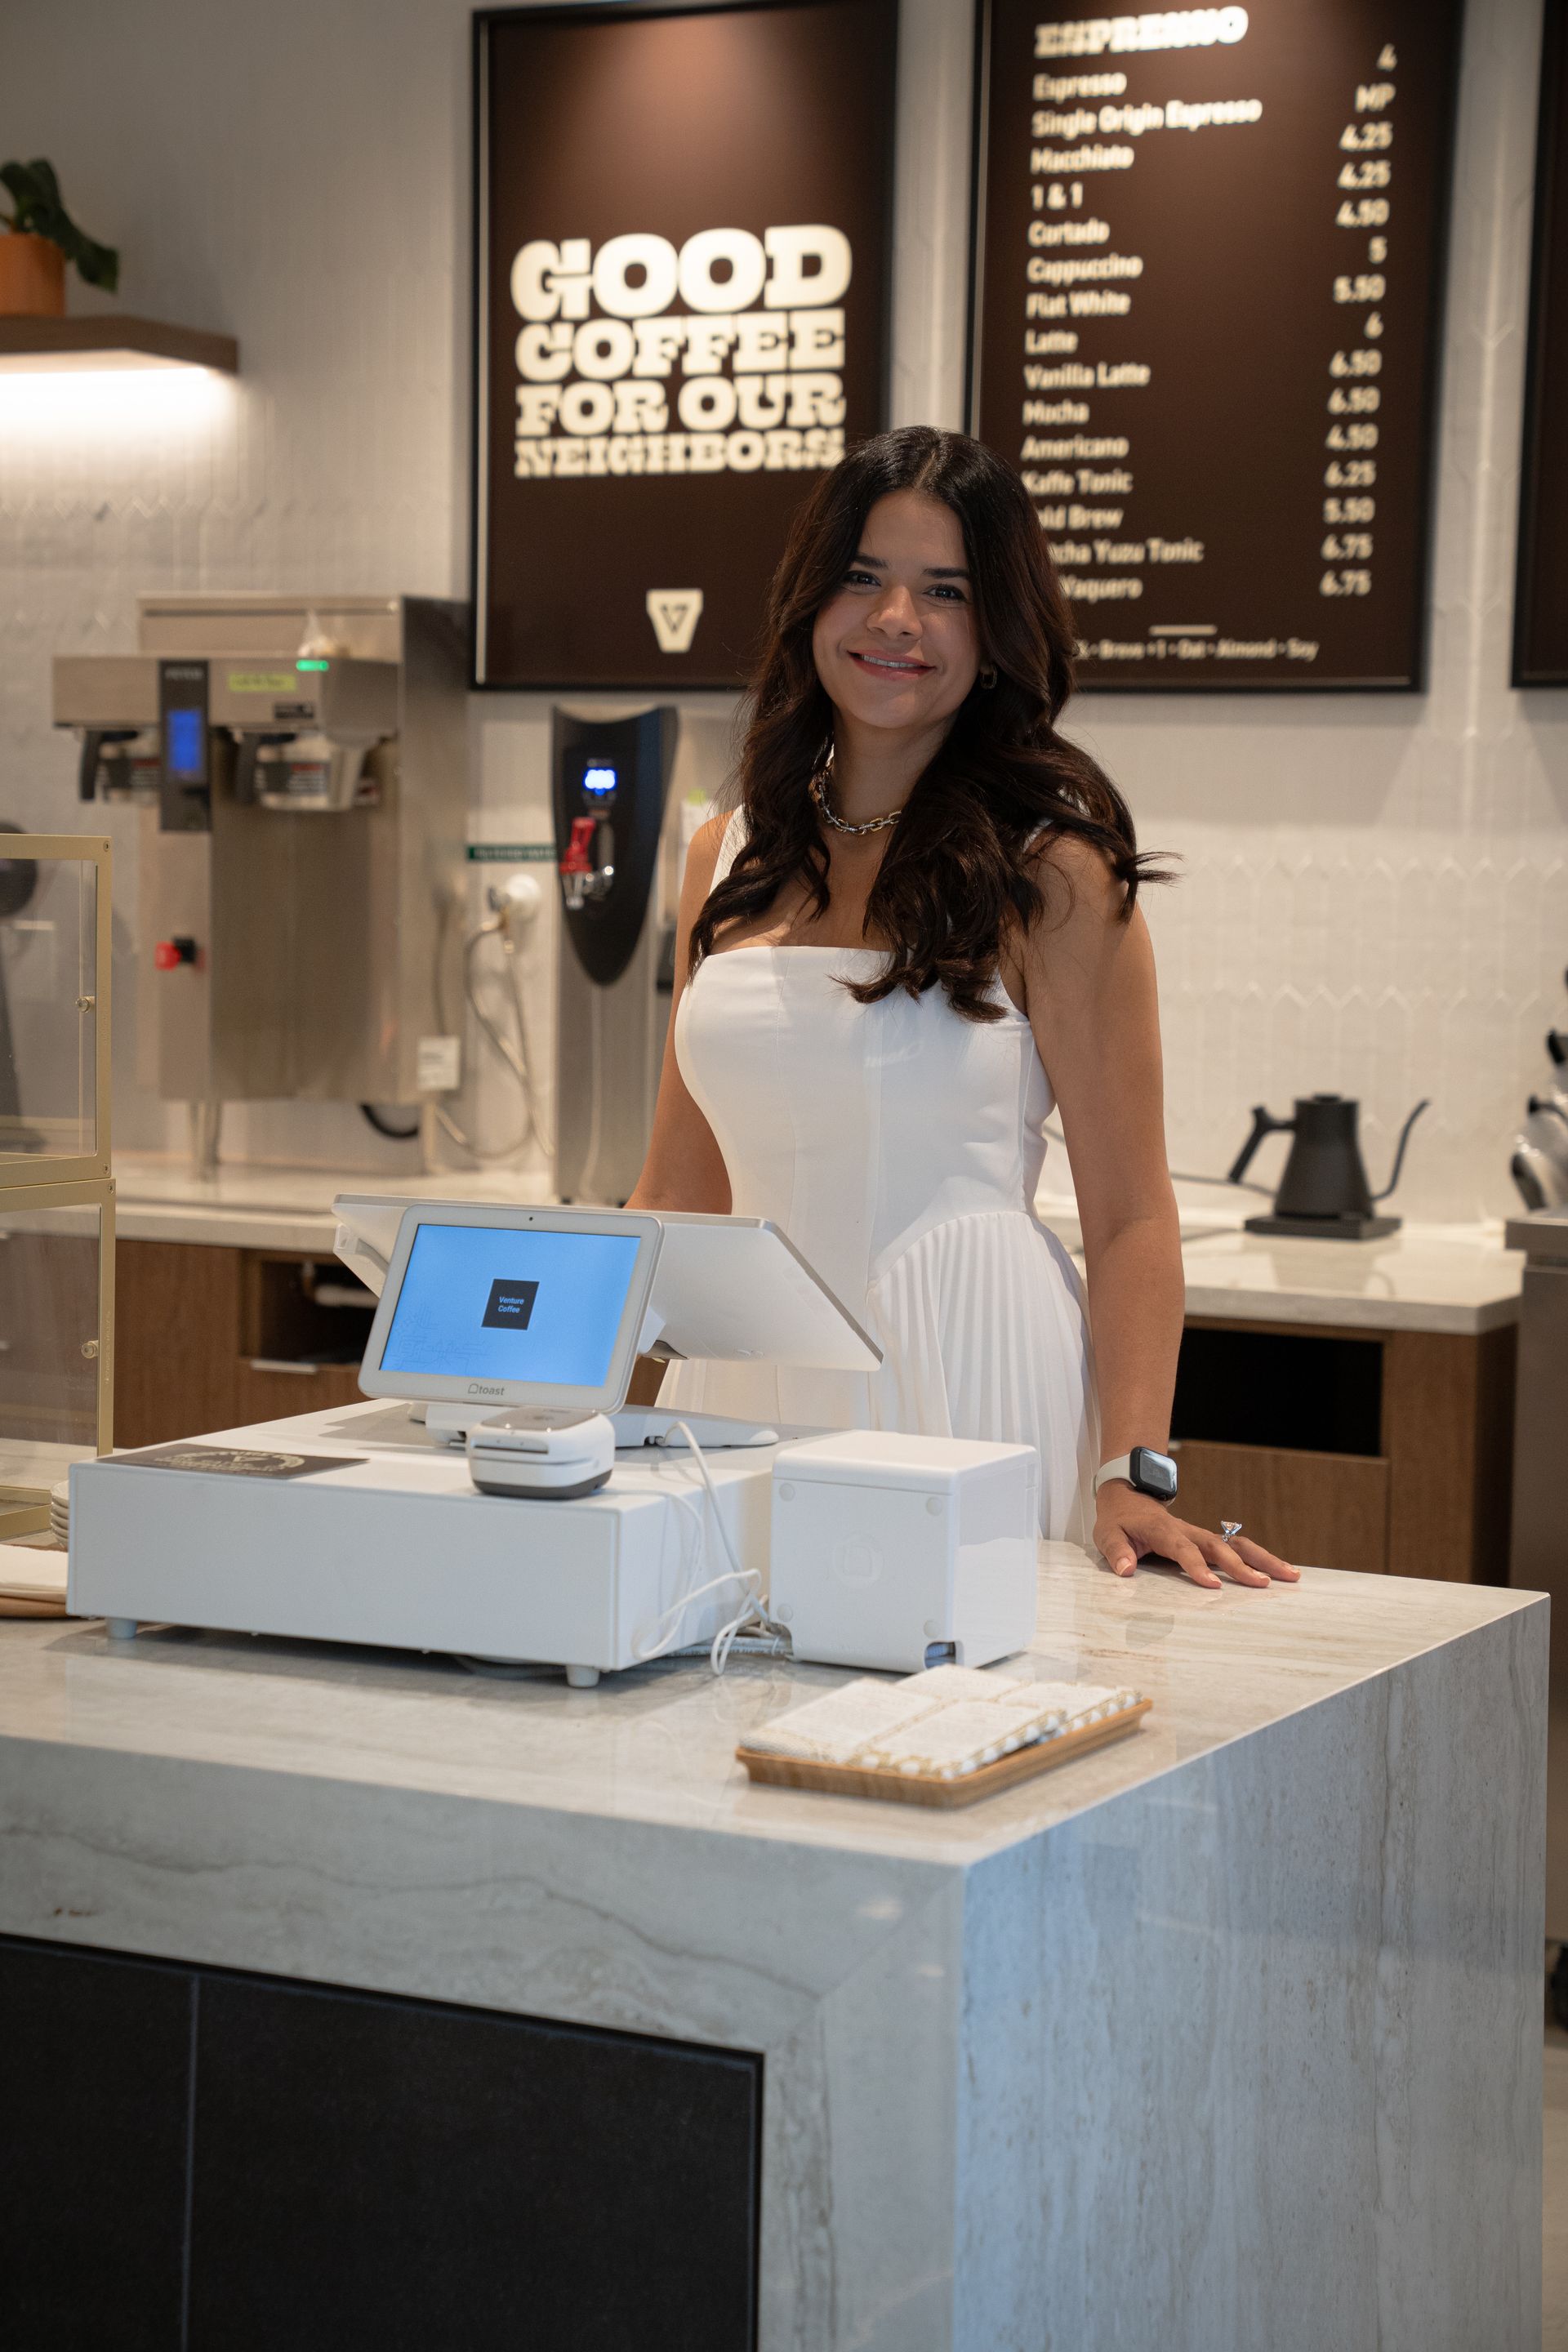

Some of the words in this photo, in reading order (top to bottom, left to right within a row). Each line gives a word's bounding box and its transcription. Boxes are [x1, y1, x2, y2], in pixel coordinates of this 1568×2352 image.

[1035, 6, 1249, 59] ESPRESSO
[1378, 45, 1396, 69] 4
[1033, 72, 1127, 104] Espresso
[1033, 109, 1098, 140] Single
[1098, 103, 1165, 136] Origin
[1165, 100, 1263, 131] Espresso
[1340, 122, 1392, 150] 4.25
[1031, 144, 1134, 172] Macchiato
[1338, 161, 1390, 189] 4.25
[1032, 185, 1044, 209] 1
[1048, 184, 1066, 208] &
[1071, 182, 1083, 207] 1
[1337, 199, 1388, 226] 4.50
[1029, 218, 1110, 246] Cortado
[1370, 237, 1387, 263] 5
[511, 225, 852, 322] GOOD
[1027, 253, 1143, 286] Cappuccino
[1334, 275, 1385, 302] 5.50
[1027, 293, 1067, 318] Flat
[1069, 291, 1130, 314] White
[1365, 313, 1383, 337] 6
[515, 308, 844, 381] COFFEE
[1026, 331, 1078, 354] Latte
[1024, 364, 1095, 389] Vanilla
[1097, 363, 1150, 386] Latte
[1330, 350, 1381, 376] 6.50
[516, 380, 669, 436] FOR
[677, 372, 846, 431] OUR
[1023, 400, 1089, 424] Mocha
[1329, 387, 1379, 413] 6.50
[1022, 435, 1129, 459] Americano
[1326, 424, 1378, 449] 4.50
[515, 429, 844, 479] NEIGHBORS
[1076, 470, 1132, 493] Tonic
[1325, 461, 1375, 487] 6.25
[1068, 505, 1123, 528] Brew
[1325, 497, 1374, 523] 5.50
[1147, 538, 1203, 562] Tonic
[1322, 534, 1372, 559] 6.75
[1321, 570, 1370, 595] 6.75
[1215, 639, 1276, 658] Almond
[1287, 638, 1319, 662] Soy
[498, 1305, 520, 1313] Coffee
[499, 1296, 524, 1305] Venture
[479, 1384, 506, 1396] toast
